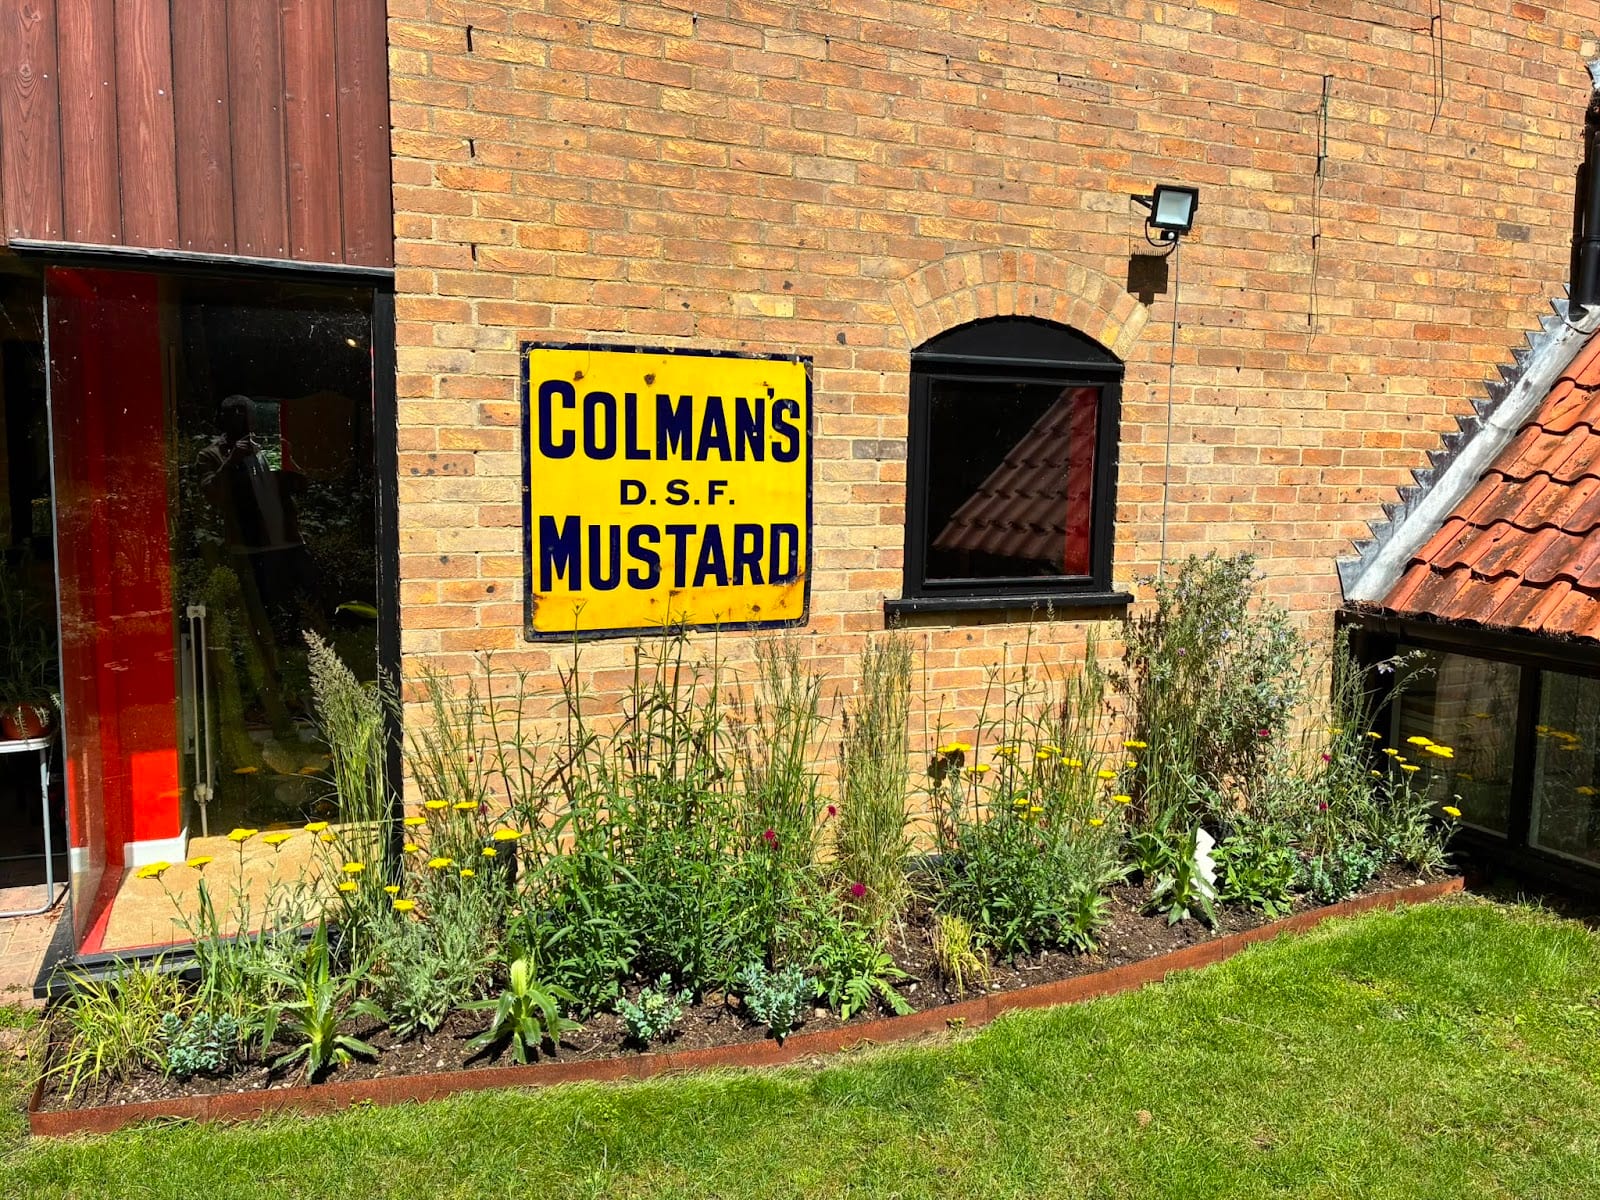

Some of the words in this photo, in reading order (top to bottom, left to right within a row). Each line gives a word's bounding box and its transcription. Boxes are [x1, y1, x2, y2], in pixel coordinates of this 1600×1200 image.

[538, 380, 800, 463] COLMAN'S
[620, 479, 735, 505] D.S.F.
[539, 515, 799, 592] MUSTARD
